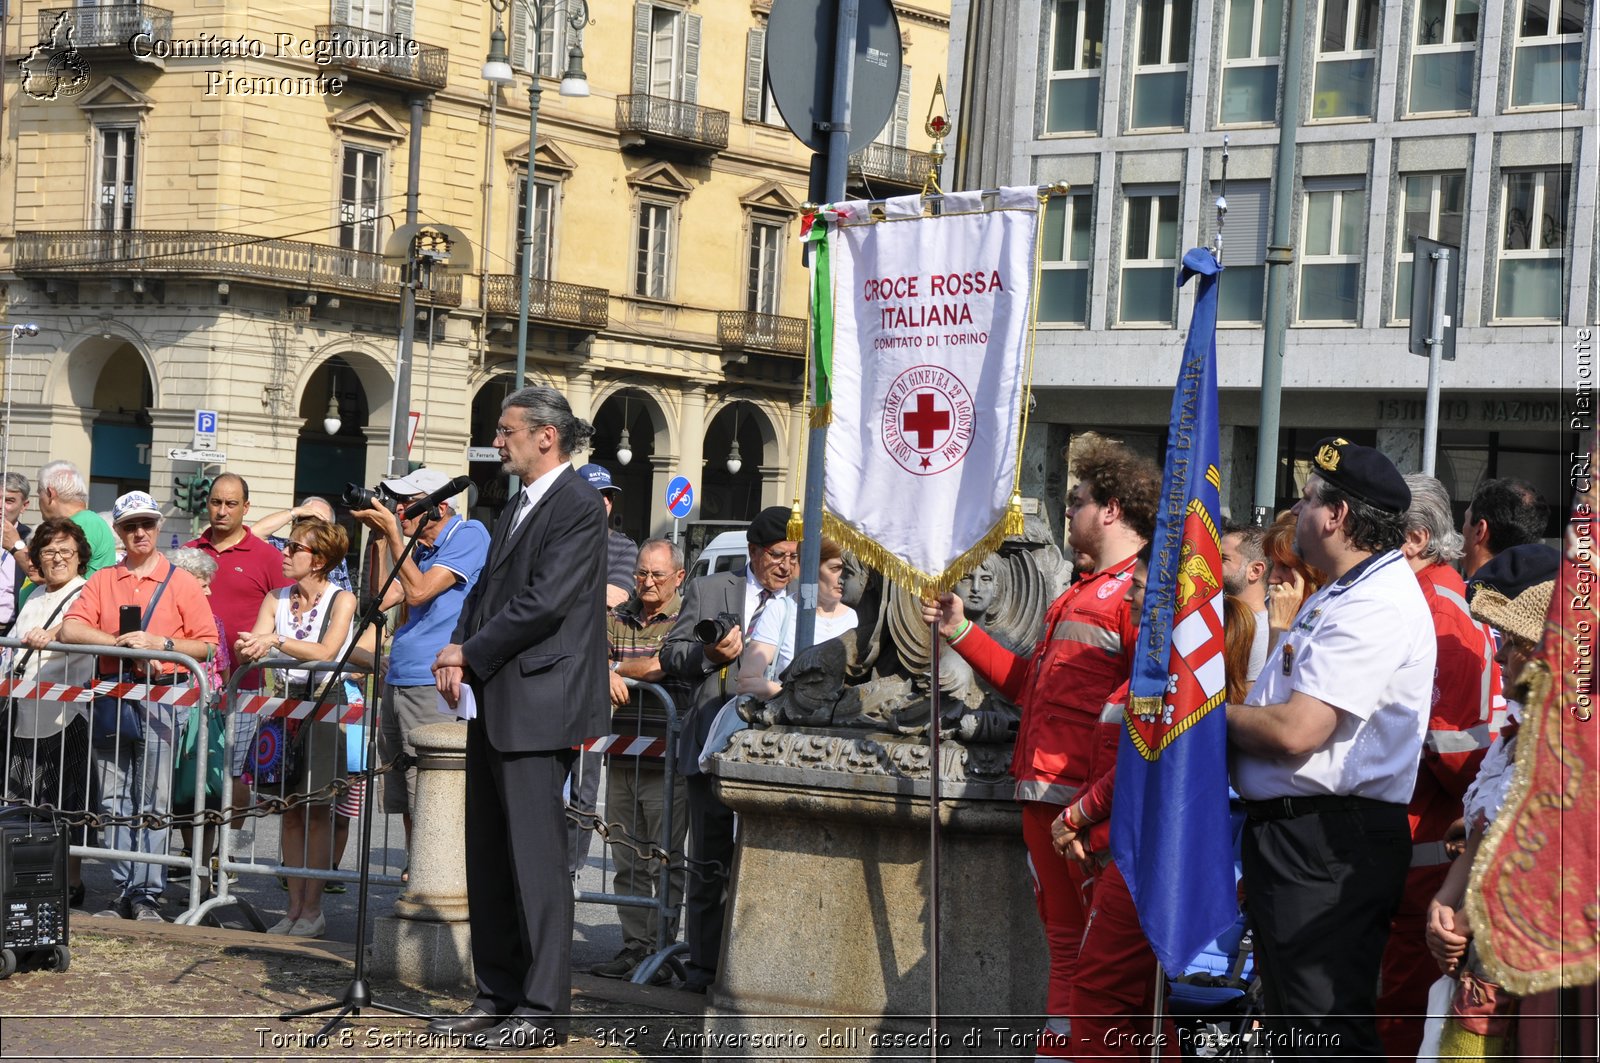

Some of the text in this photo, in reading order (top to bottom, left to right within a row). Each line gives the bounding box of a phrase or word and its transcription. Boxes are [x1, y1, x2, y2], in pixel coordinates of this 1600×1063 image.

[864, 270, 1004, 302] CROCE ROSSA
[881, 303, 974, 330] ITALIANA
[874, 331, 988, 350] COMITATO DI TORINO
[885, 369, 972, 463] CONVENZIONE DI GINEVRA 22 AGOSTO 1864
[1176, 353, 1205, 450] D'ITALIA
[202, 417, 212, 432] P
[1164, 457, 1190, 548] MARINAI
